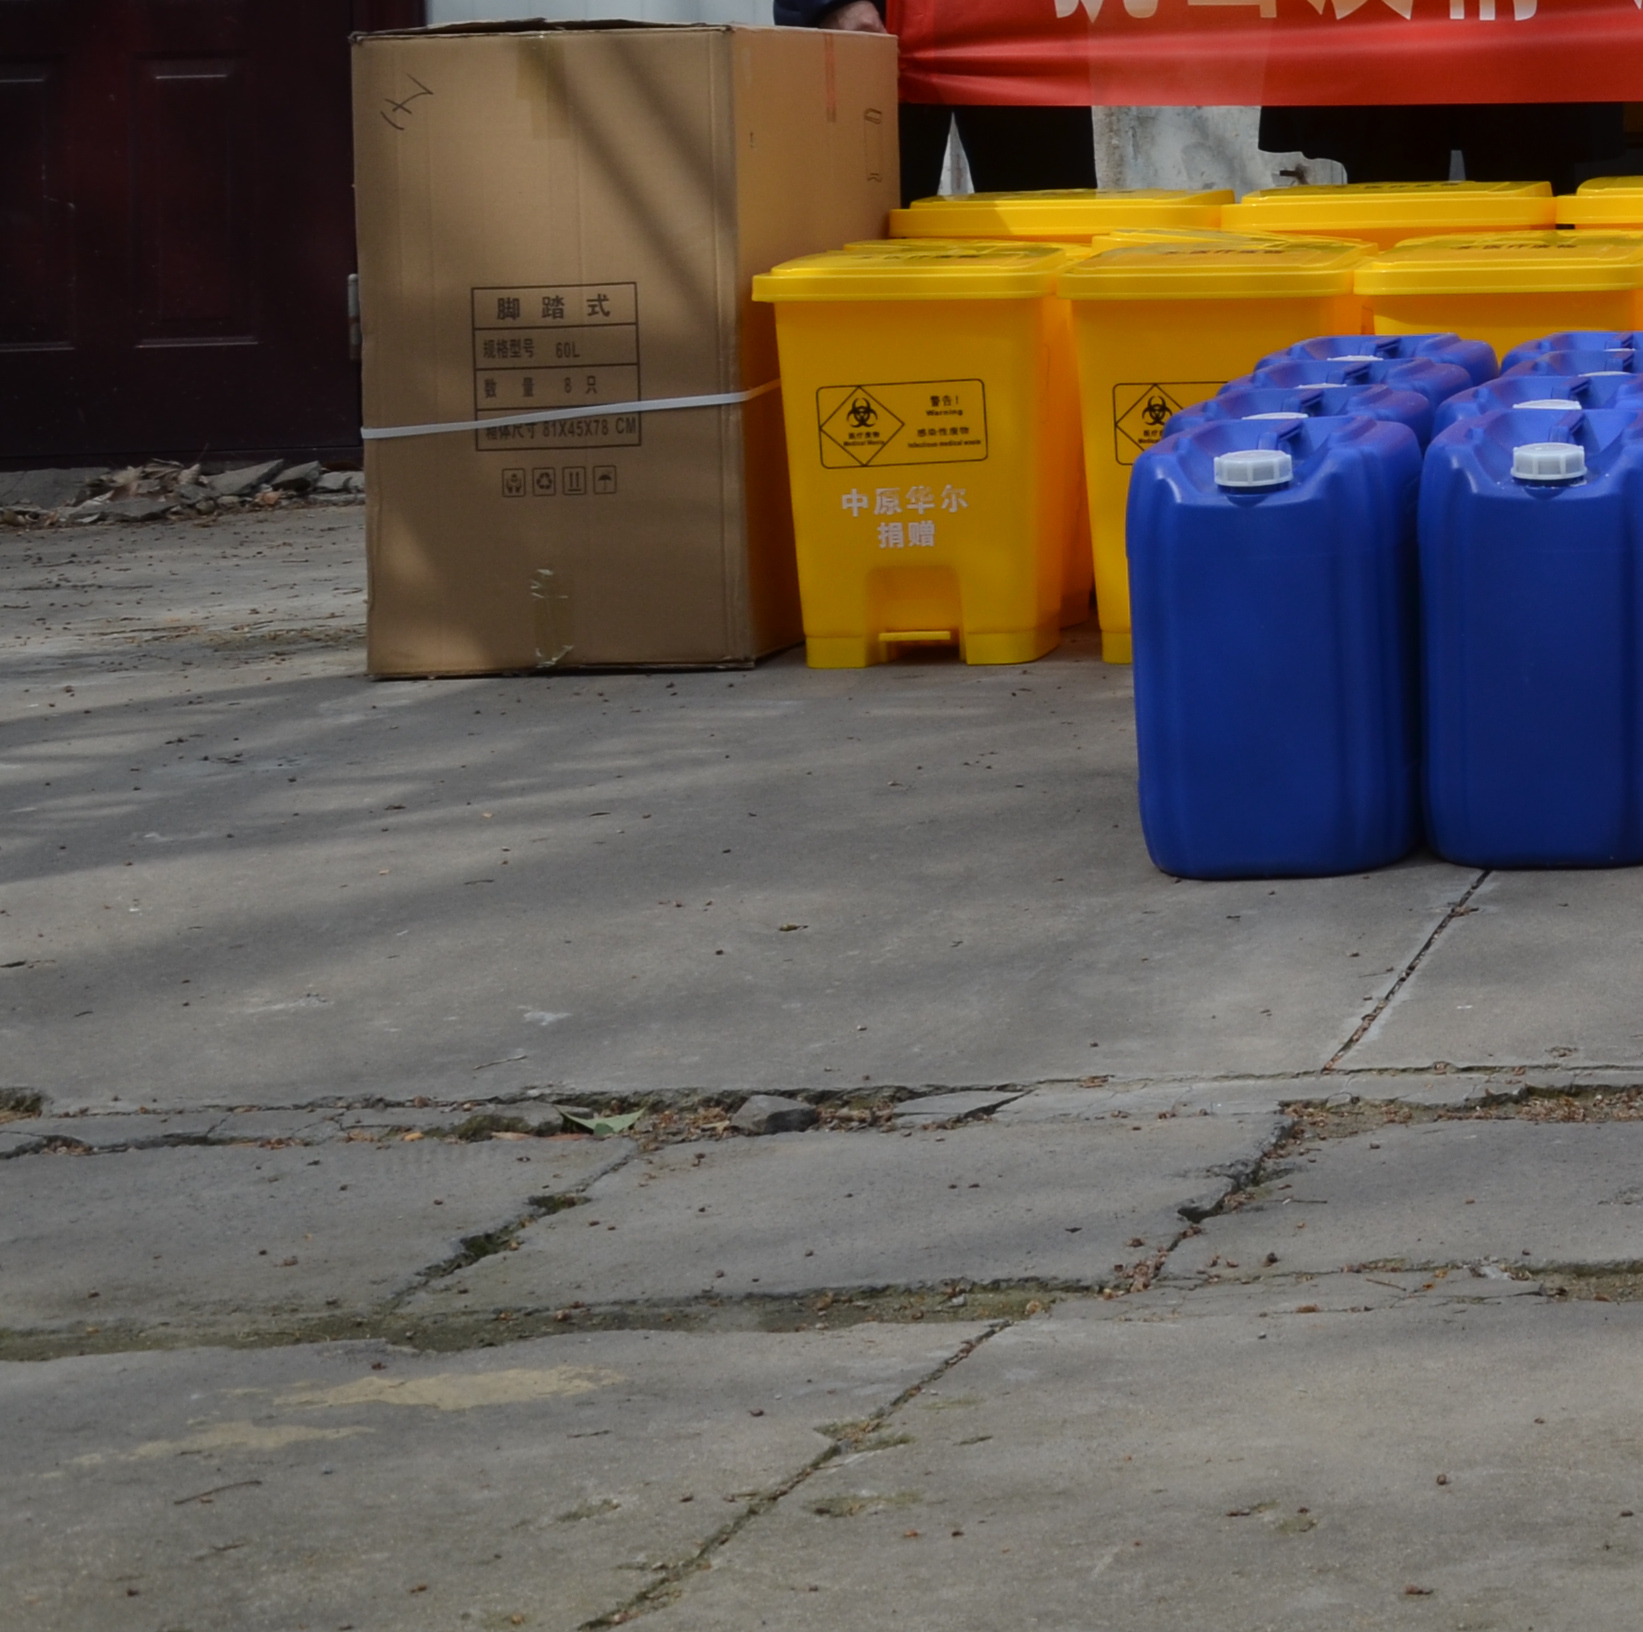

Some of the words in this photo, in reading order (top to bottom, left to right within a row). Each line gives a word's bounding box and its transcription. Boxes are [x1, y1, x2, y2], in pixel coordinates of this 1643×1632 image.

[497, 293, 610, 320] 脚踏式
[483, 338, 535, 359] 规格型号
[555, 341, 580, 358] 60L
[616, 417, 637, 434] CM
[841, 484, 969, 517] 中原华尔
[877, 520, 935, 548] 捐赠
